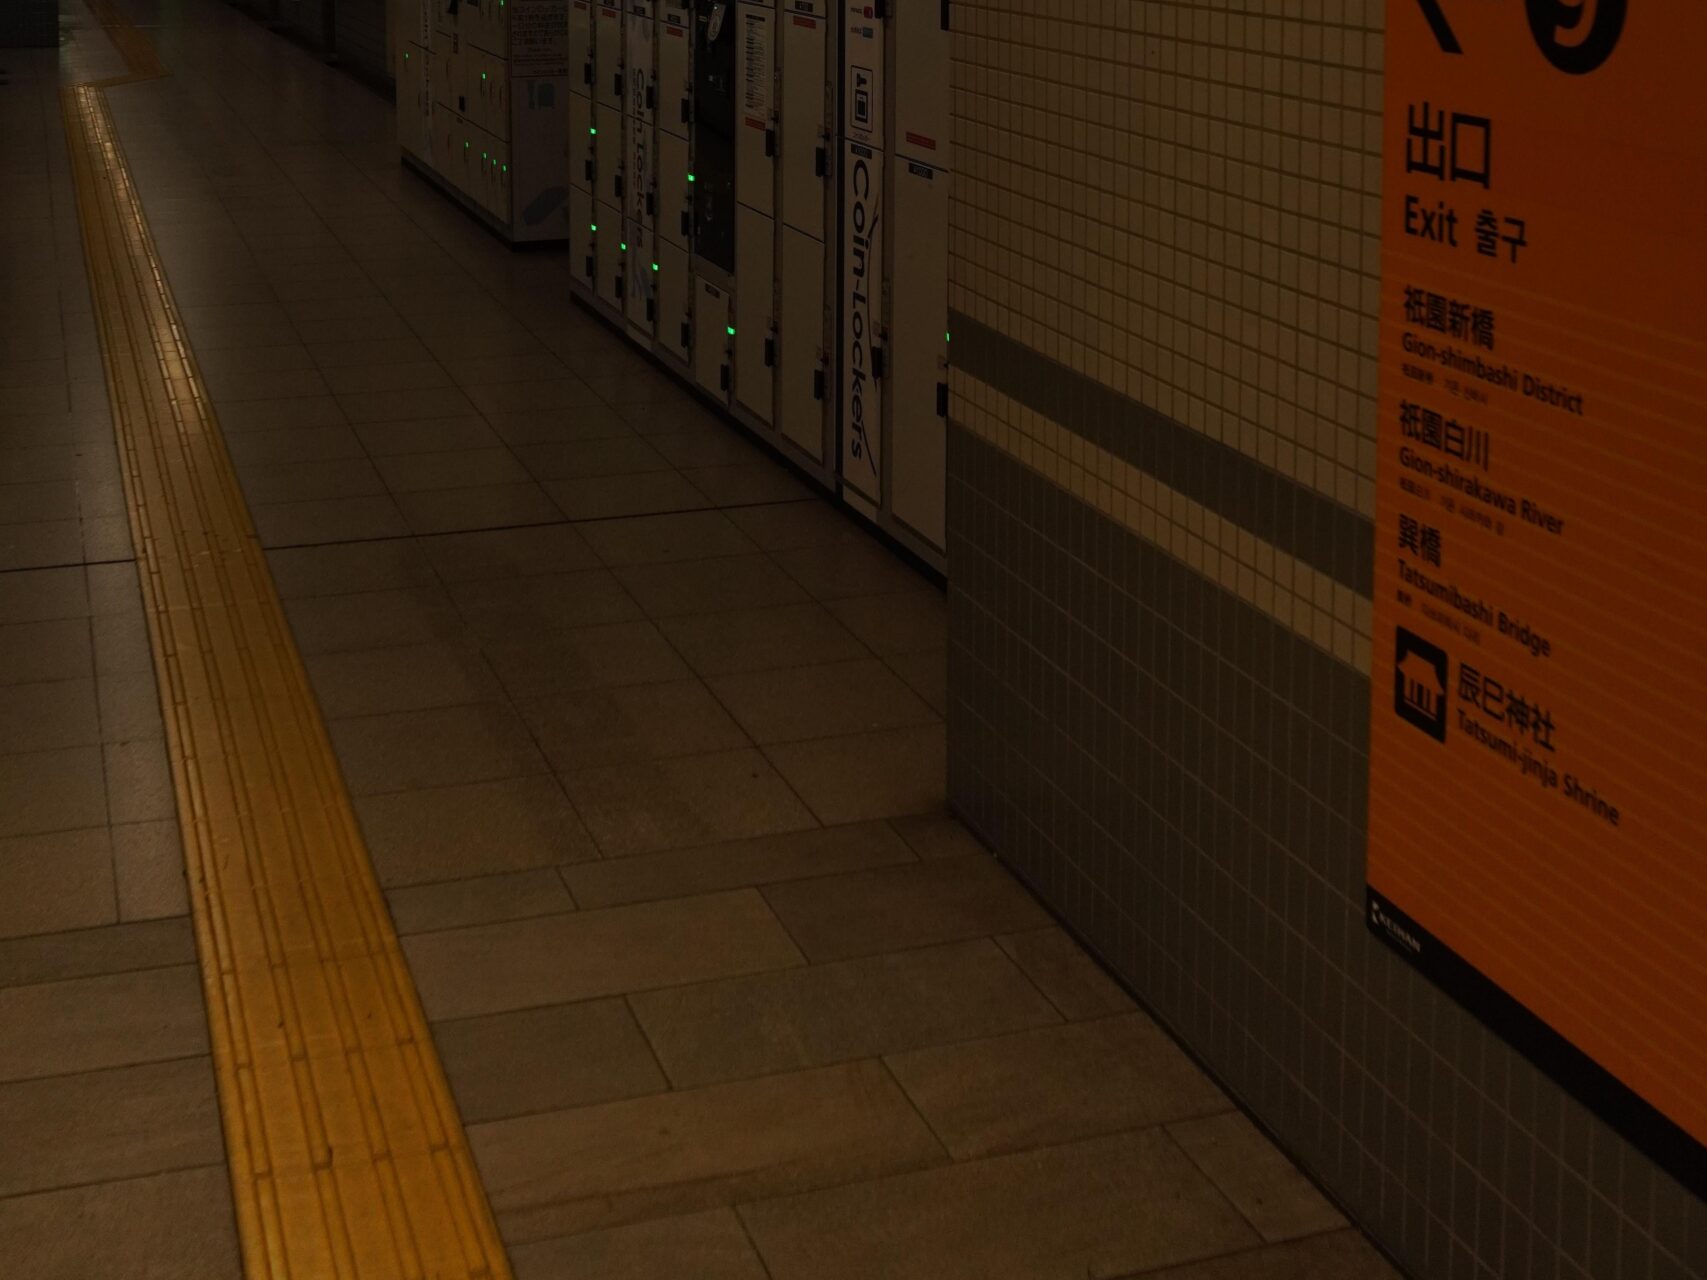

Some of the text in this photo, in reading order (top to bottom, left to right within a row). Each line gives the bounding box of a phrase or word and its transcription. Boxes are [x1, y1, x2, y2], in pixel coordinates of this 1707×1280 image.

[1406, 102, 1491, 190] 出口
[1405, 195, 1527, 264] Exit 출구
[1402, 332, 1518, 392] Gion-shimbashi
[1522, 374, 1583, 416] District
[1400, 401, 1490, 473] 祇園白川
[1400, 446, 1517, 515] Gion-shirakawa
[1521, 498, 1565, 535] River
[1398, 558, 1493, 626] Tatsumibashi
[1498, 611, 1551, 657] Bridge
[1458, 662, 1555, 752] 辰巳神社
[1457, 708, 1620, 826] Tatsumi-jinja Shrine
